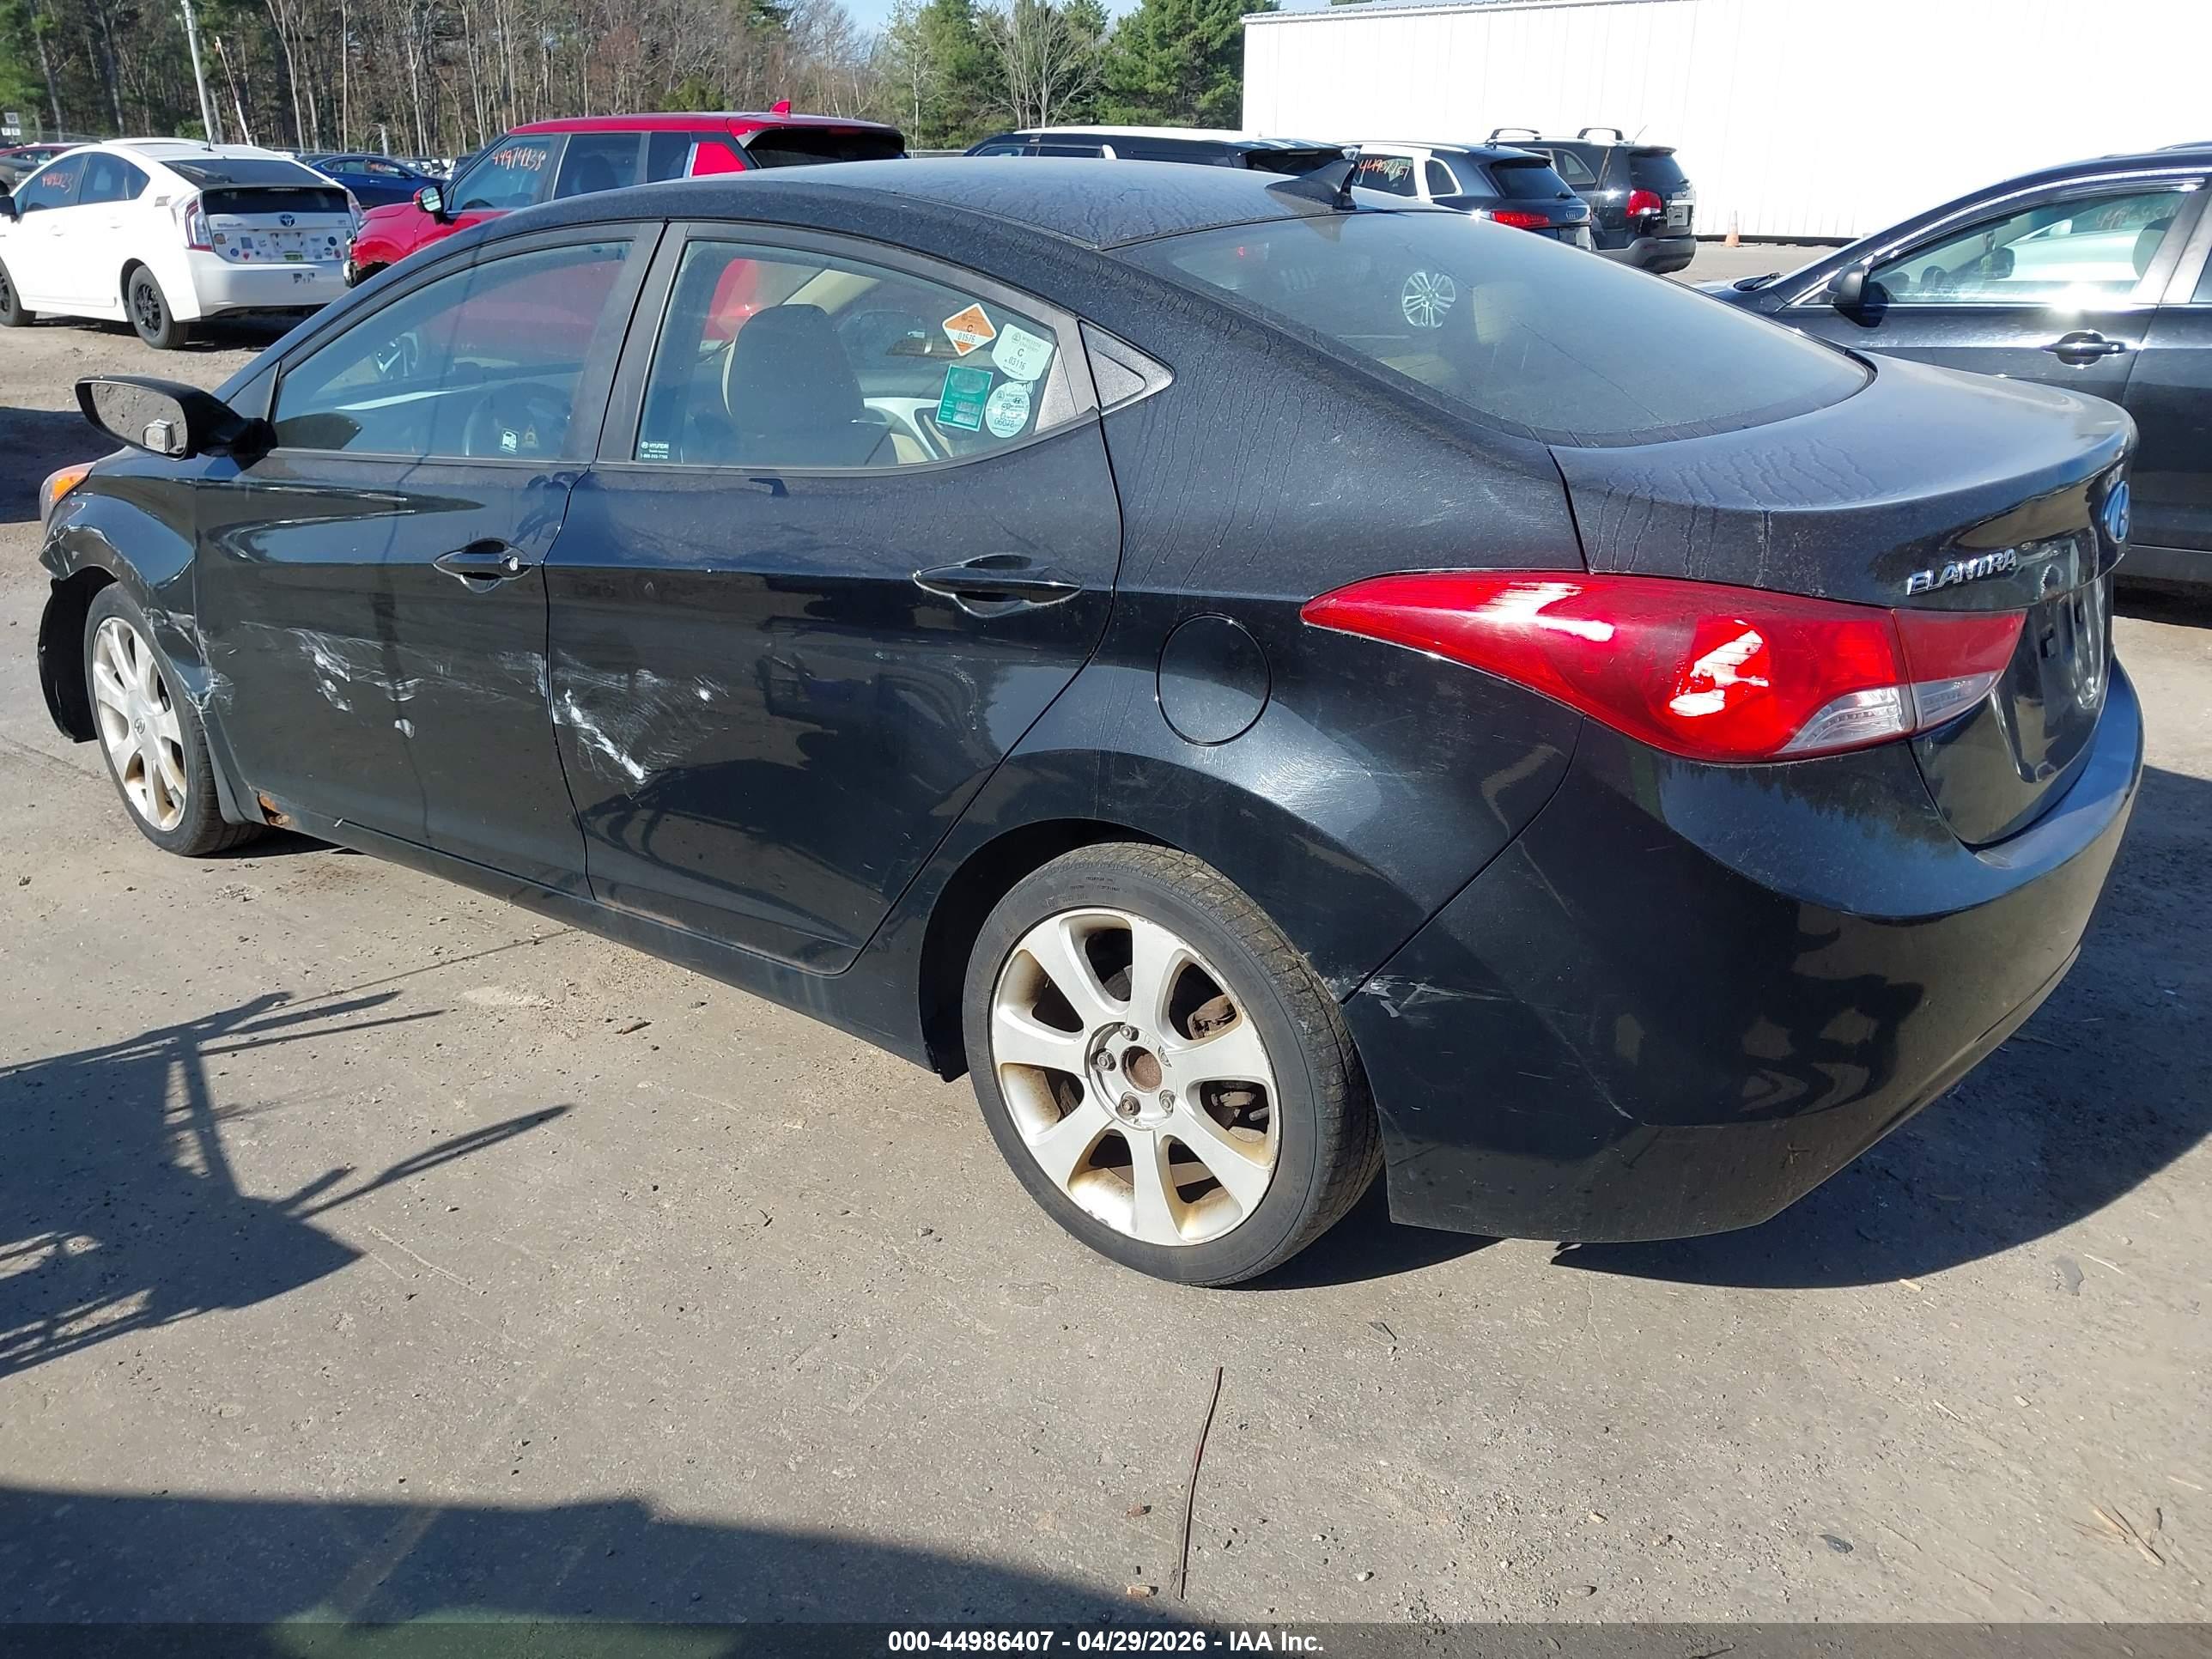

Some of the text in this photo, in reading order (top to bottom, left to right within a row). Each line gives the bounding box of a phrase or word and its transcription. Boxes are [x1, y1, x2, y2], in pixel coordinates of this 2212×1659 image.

[967, 324, 974, 333] C
[1018, 348, 1024, 357] C
[1906, 549, 2017, 596] ELANTRA
